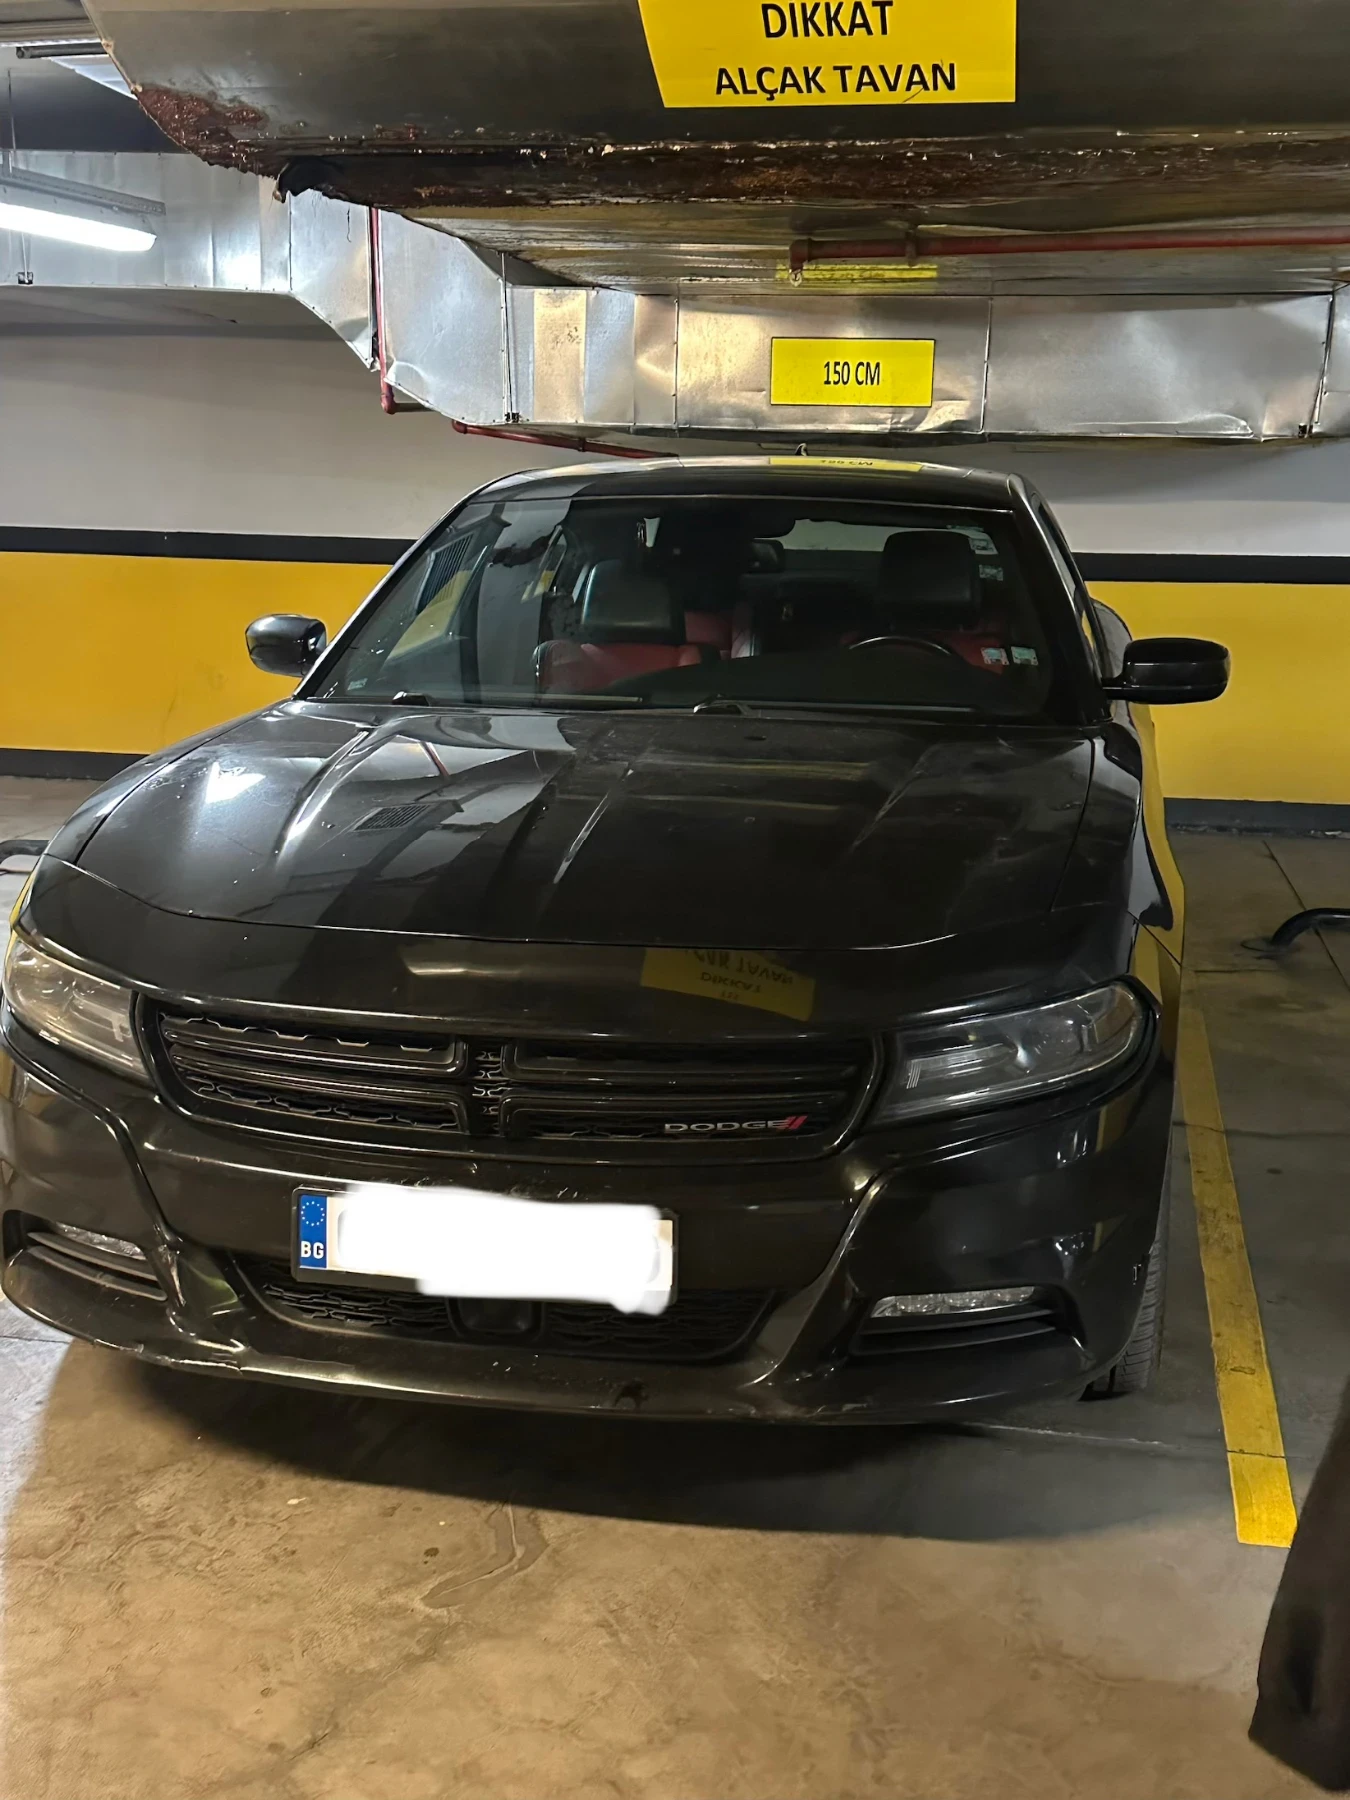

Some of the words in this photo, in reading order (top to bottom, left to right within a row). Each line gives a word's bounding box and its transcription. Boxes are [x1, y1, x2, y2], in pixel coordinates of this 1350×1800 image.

[716, 67, 825, 101] ALÇAK
[833, 64, 955, 92] TAVAN
[824, 362, 850, 385] 150
[856, 362, 879, 385] CM
[664, 1119, 790, 1132] DODGE
[300, 1240, 326, 1260] BG
